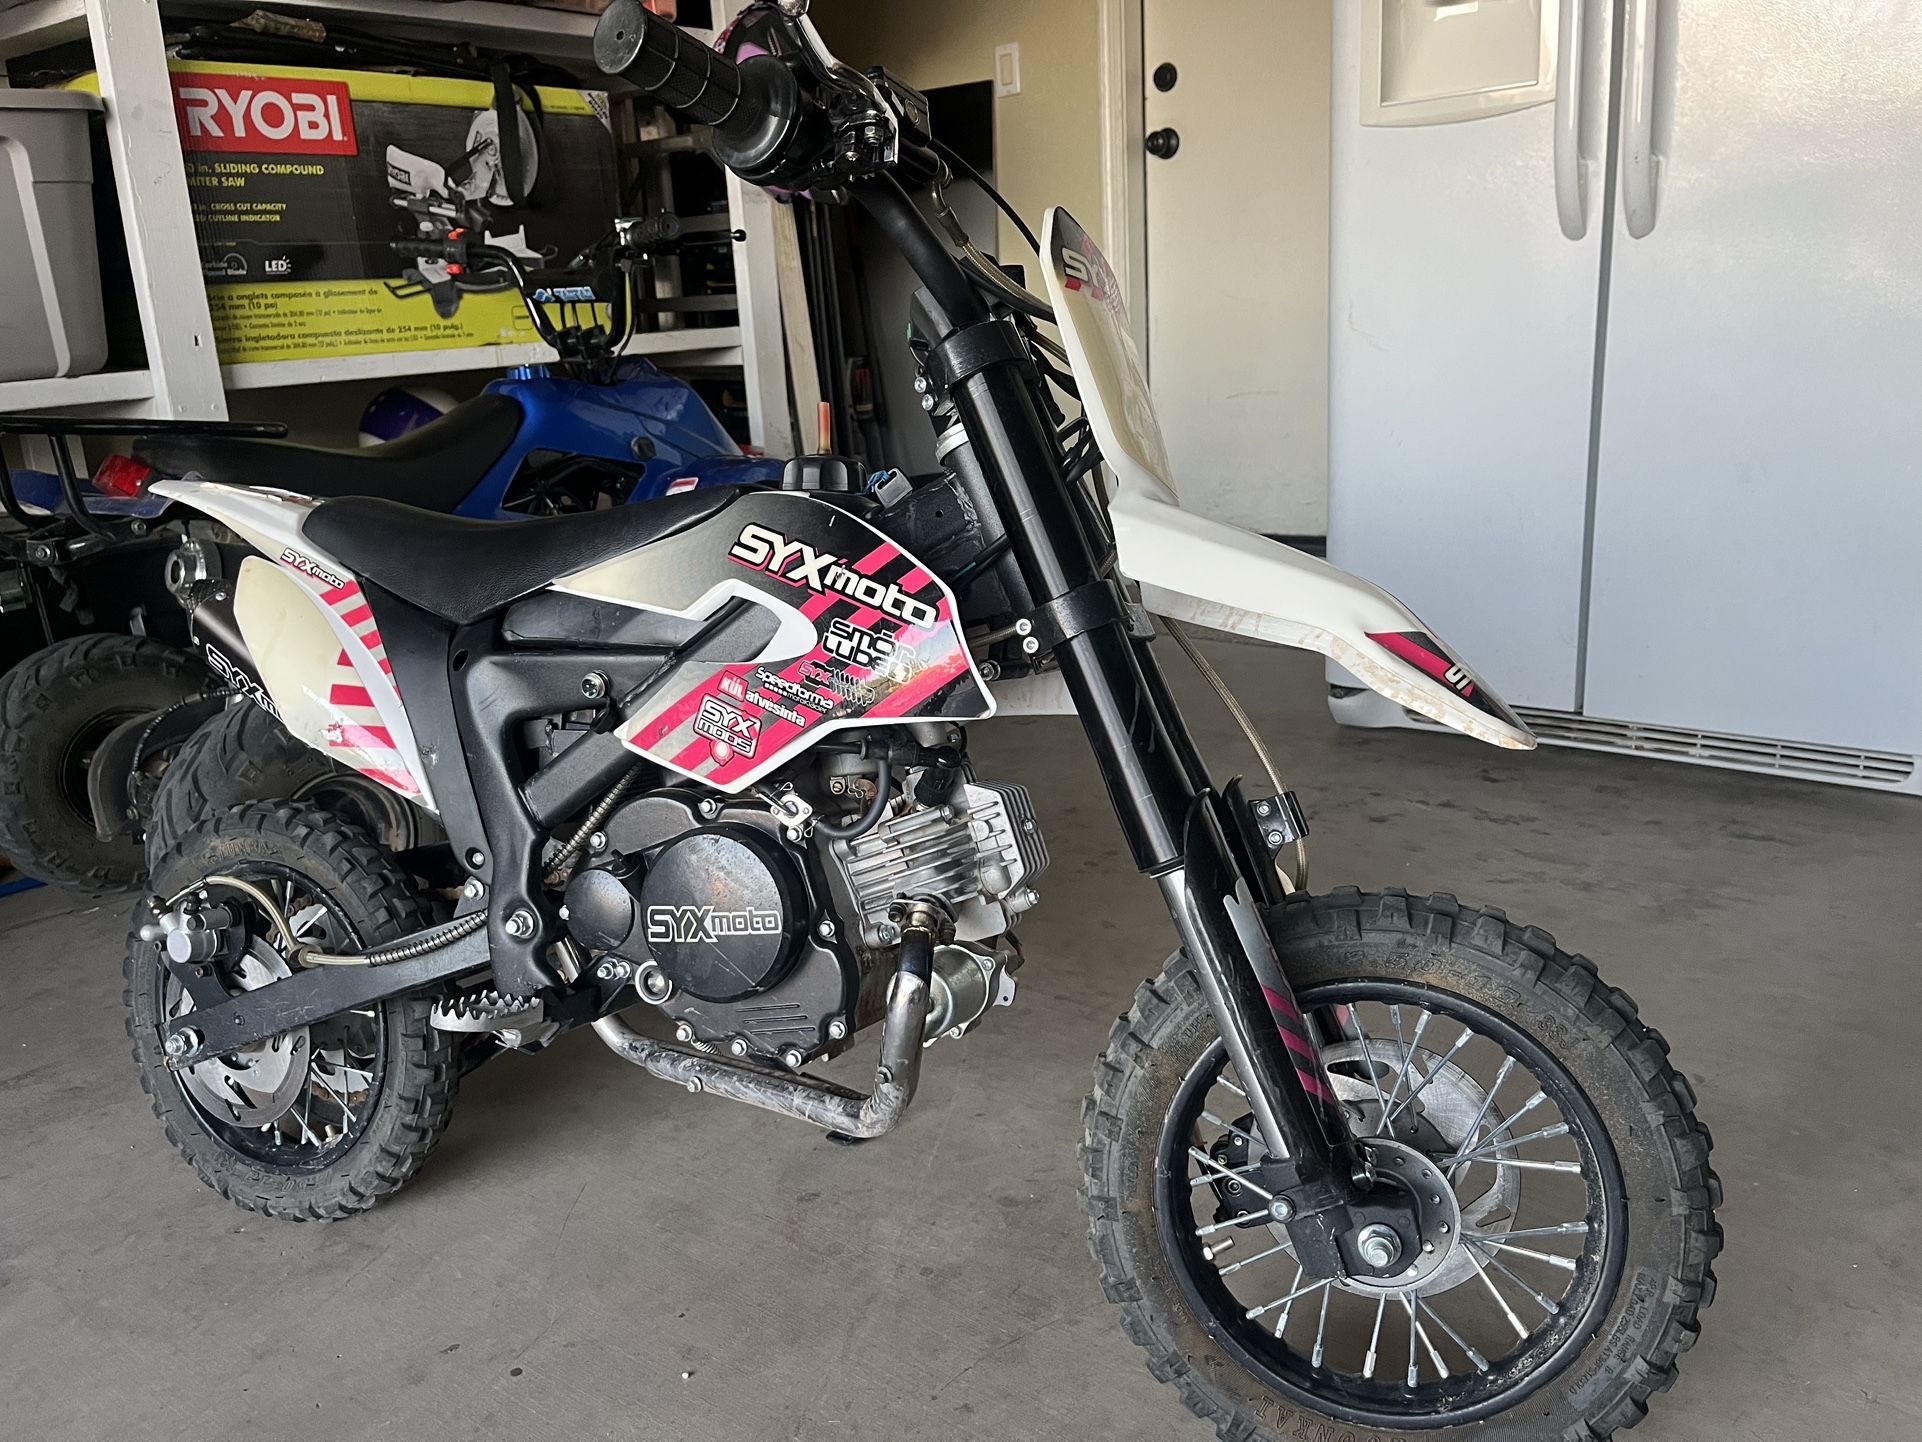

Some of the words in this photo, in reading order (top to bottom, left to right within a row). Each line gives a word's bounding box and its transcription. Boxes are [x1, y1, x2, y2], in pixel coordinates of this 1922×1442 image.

[178, 87, 343, 141] RYOBI
[214, 163, 259, 174] SLIDING
[261, 163, 325, 175] COMPOUND
[221, 177, 245, 187] SAW
[210, 203, 235, 211] CROSS
[236, 203, 251, 211] CUT
[252, 203, 287, 211] CAPACITY
[240, 214, 281, 222] INDICATOR
[265, 260, 287, 272] LED
[236, 291, 268, 302] onglets
[244, 332, 296, 344] ingletadora
[281, 547, 345, 590] SYXmoto
[729, 523, 940, 630] SYXmoto
[799, 661, 833, 685] SYX
[701, 699, 757, 741] SYX
[648, 905, 781, 943] SYXmoto
